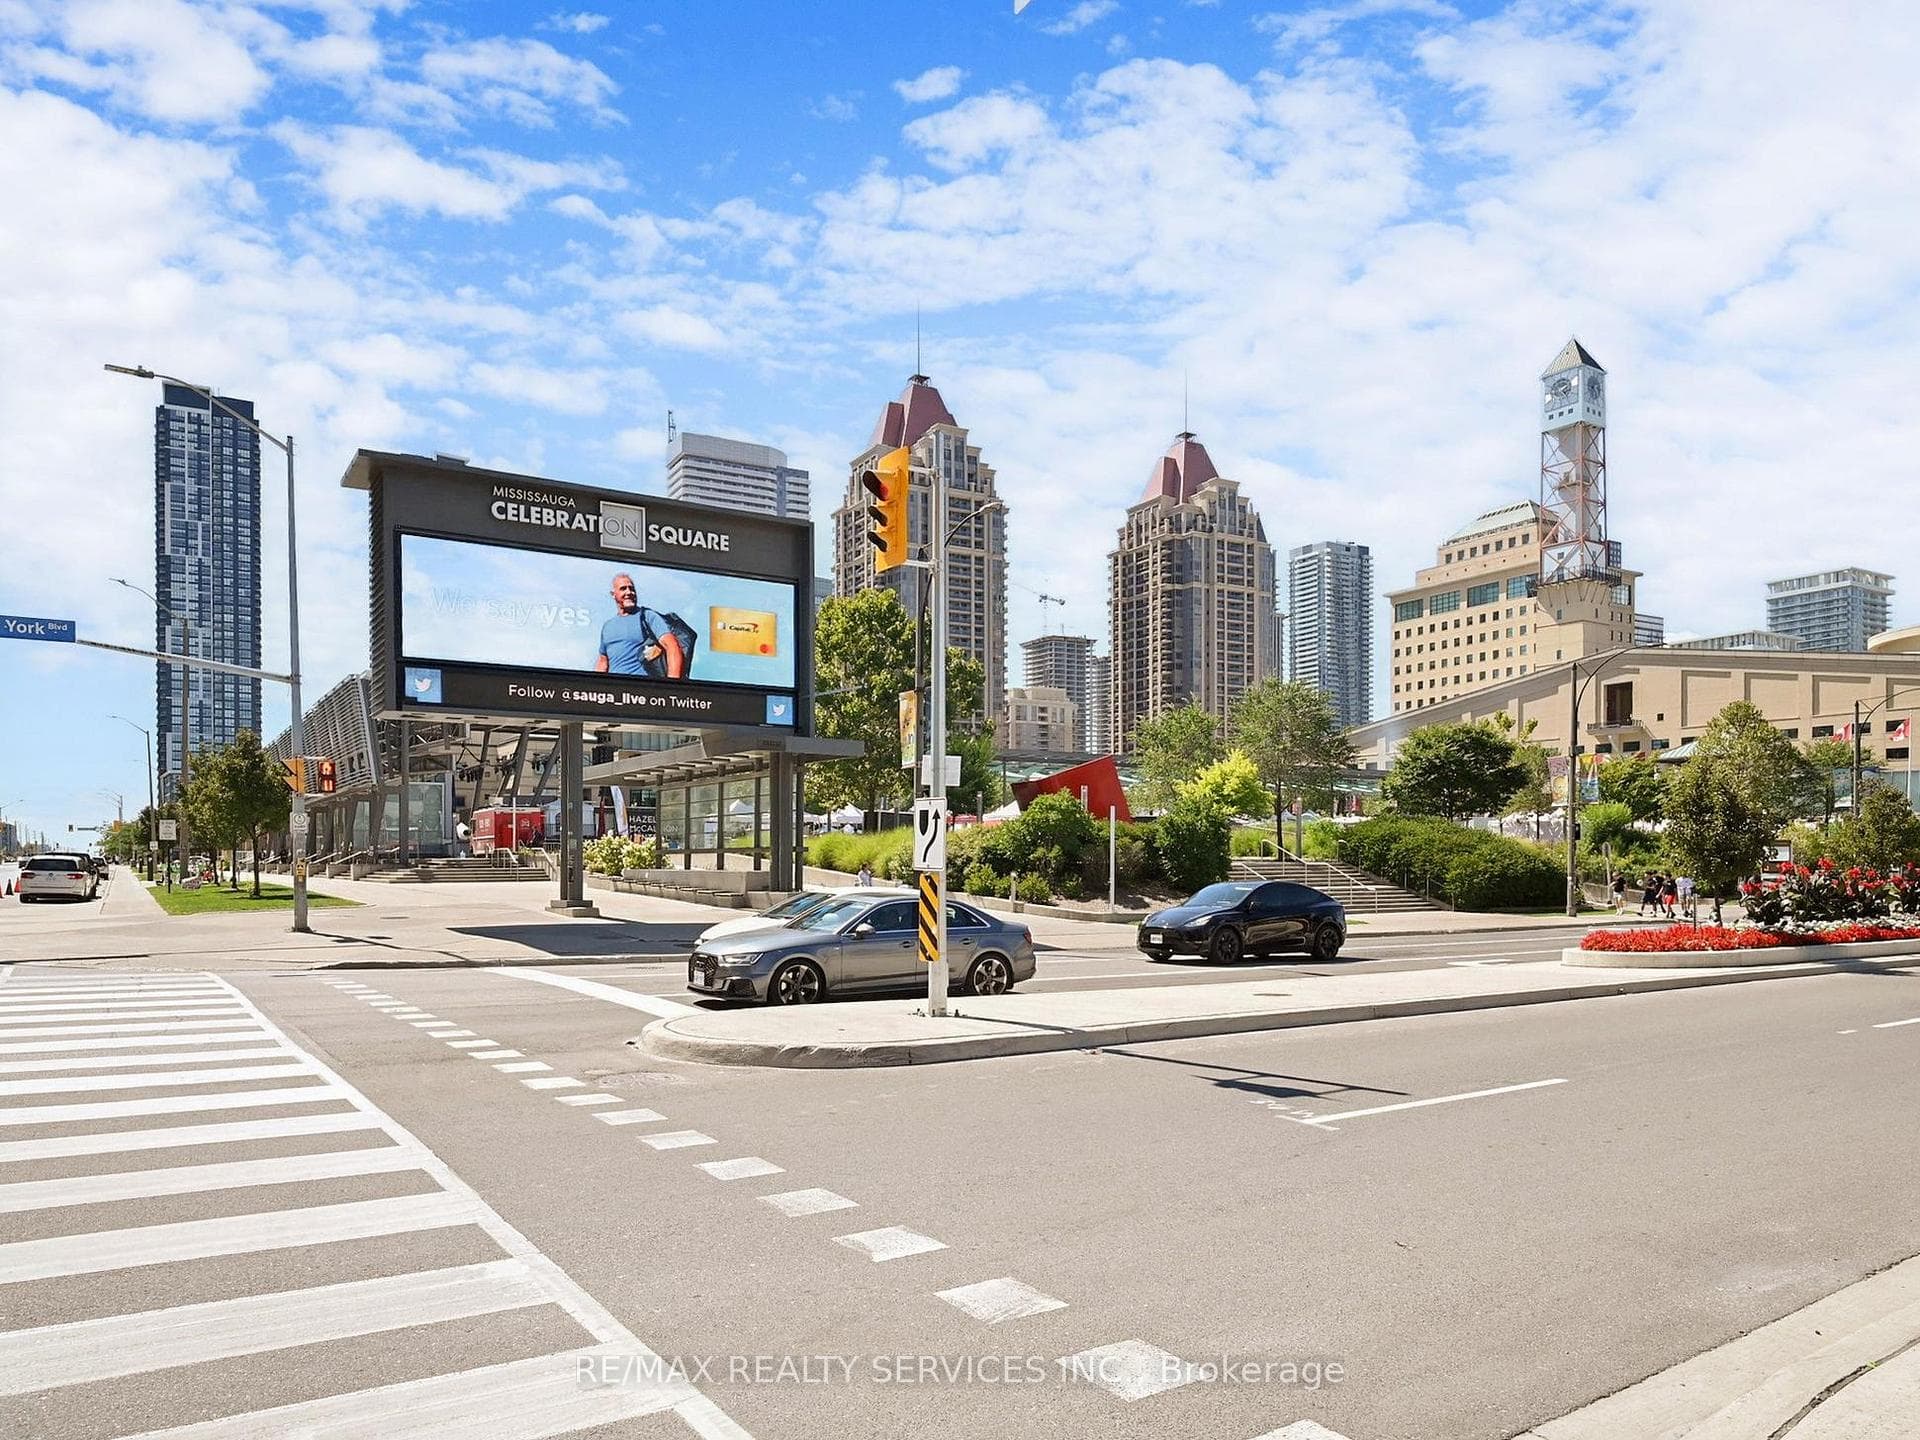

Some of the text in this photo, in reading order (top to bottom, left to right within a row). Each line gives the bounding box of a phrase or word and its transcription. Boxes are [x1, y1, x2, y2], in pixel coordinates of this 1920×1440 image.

[493, 486, 576, 508] MISSISSAUGA
[649, 524, 729, 551] SQUARE
[5, 619, 68, 634] York Blvd
[542, 604, 592, 627] yes
[508, 684, 712, 710] Follow @sauga_live on Twitter
